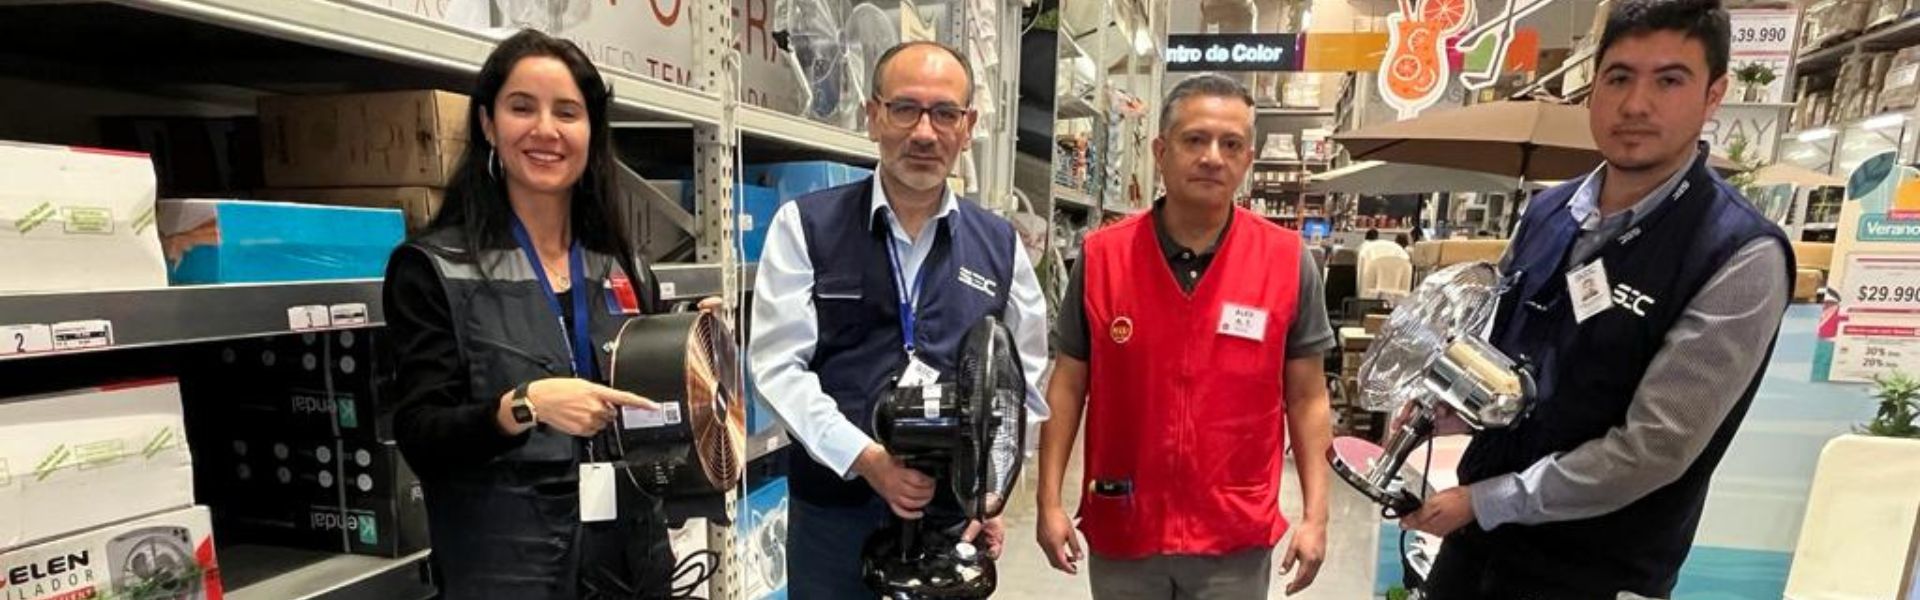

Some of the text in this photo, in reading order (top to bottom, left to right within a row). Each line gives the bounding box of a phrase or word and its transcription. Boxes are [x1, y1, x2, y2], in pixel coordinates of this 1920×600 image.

[1205, 44, 1230, 62] de
[1232, 44, 1283, 62] Color
[1613, 283, 1656, 317] SEC
